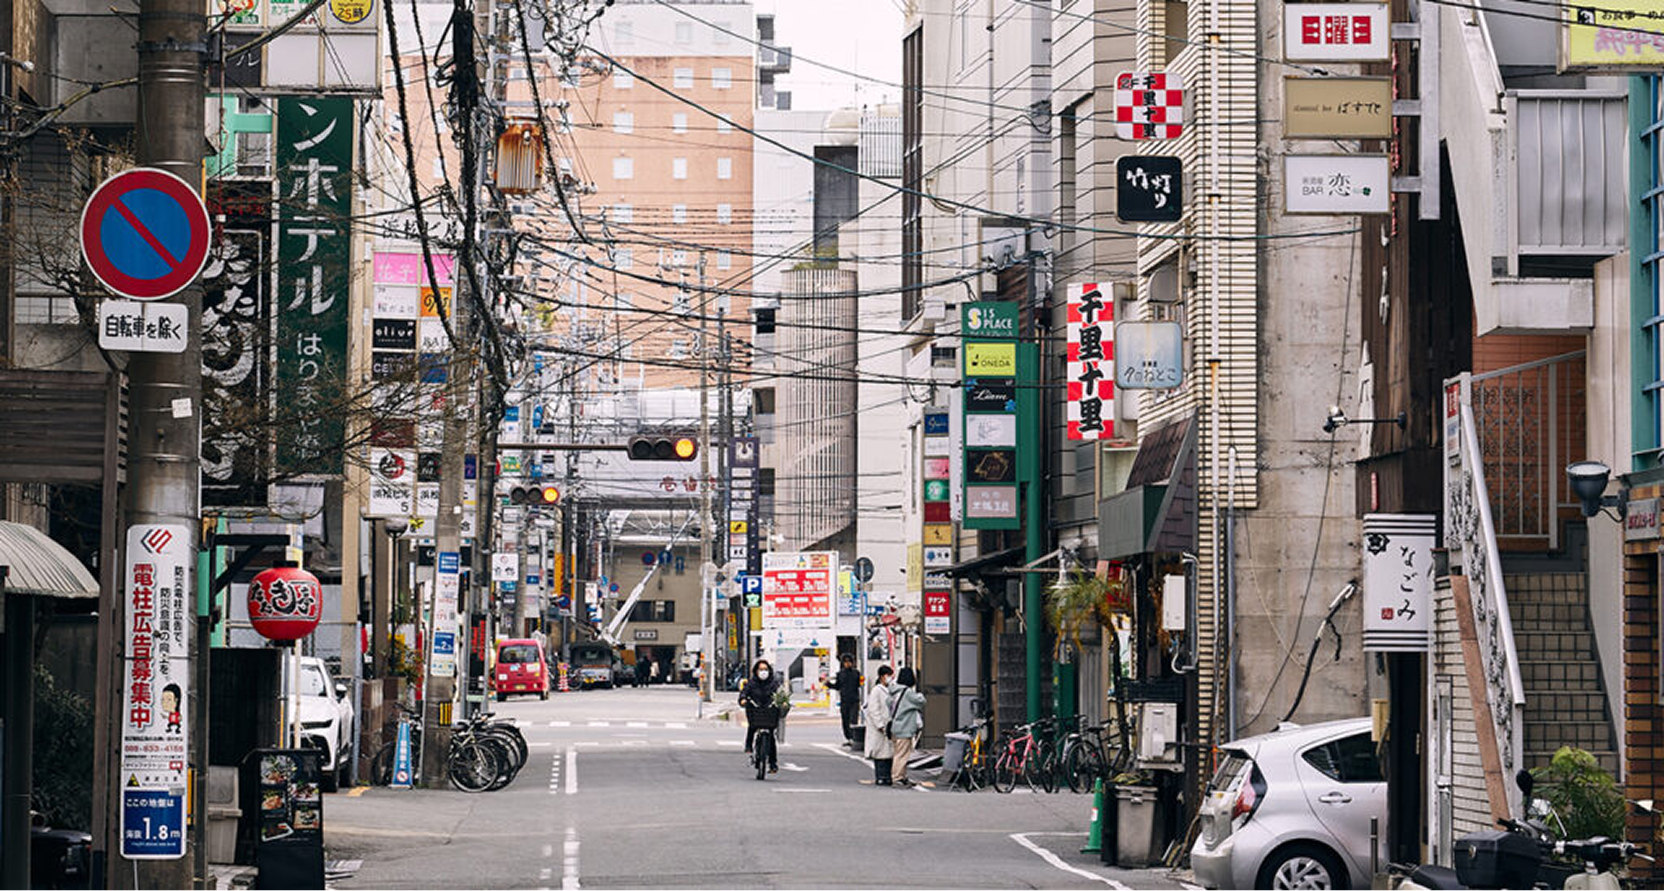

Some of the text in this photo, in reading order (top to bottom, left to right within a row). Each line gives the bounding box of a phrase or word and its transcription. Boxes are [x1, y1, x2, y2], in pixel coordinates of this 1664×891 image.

[1302, 186, 1324, 195] BAR
[1328, 173, 1351, 196] 恋
[105, 316, 183, 346] 自転車を除く
[748, 578, 760, 593] P
[130, 563, 155, 729] 電柱広告募集中
